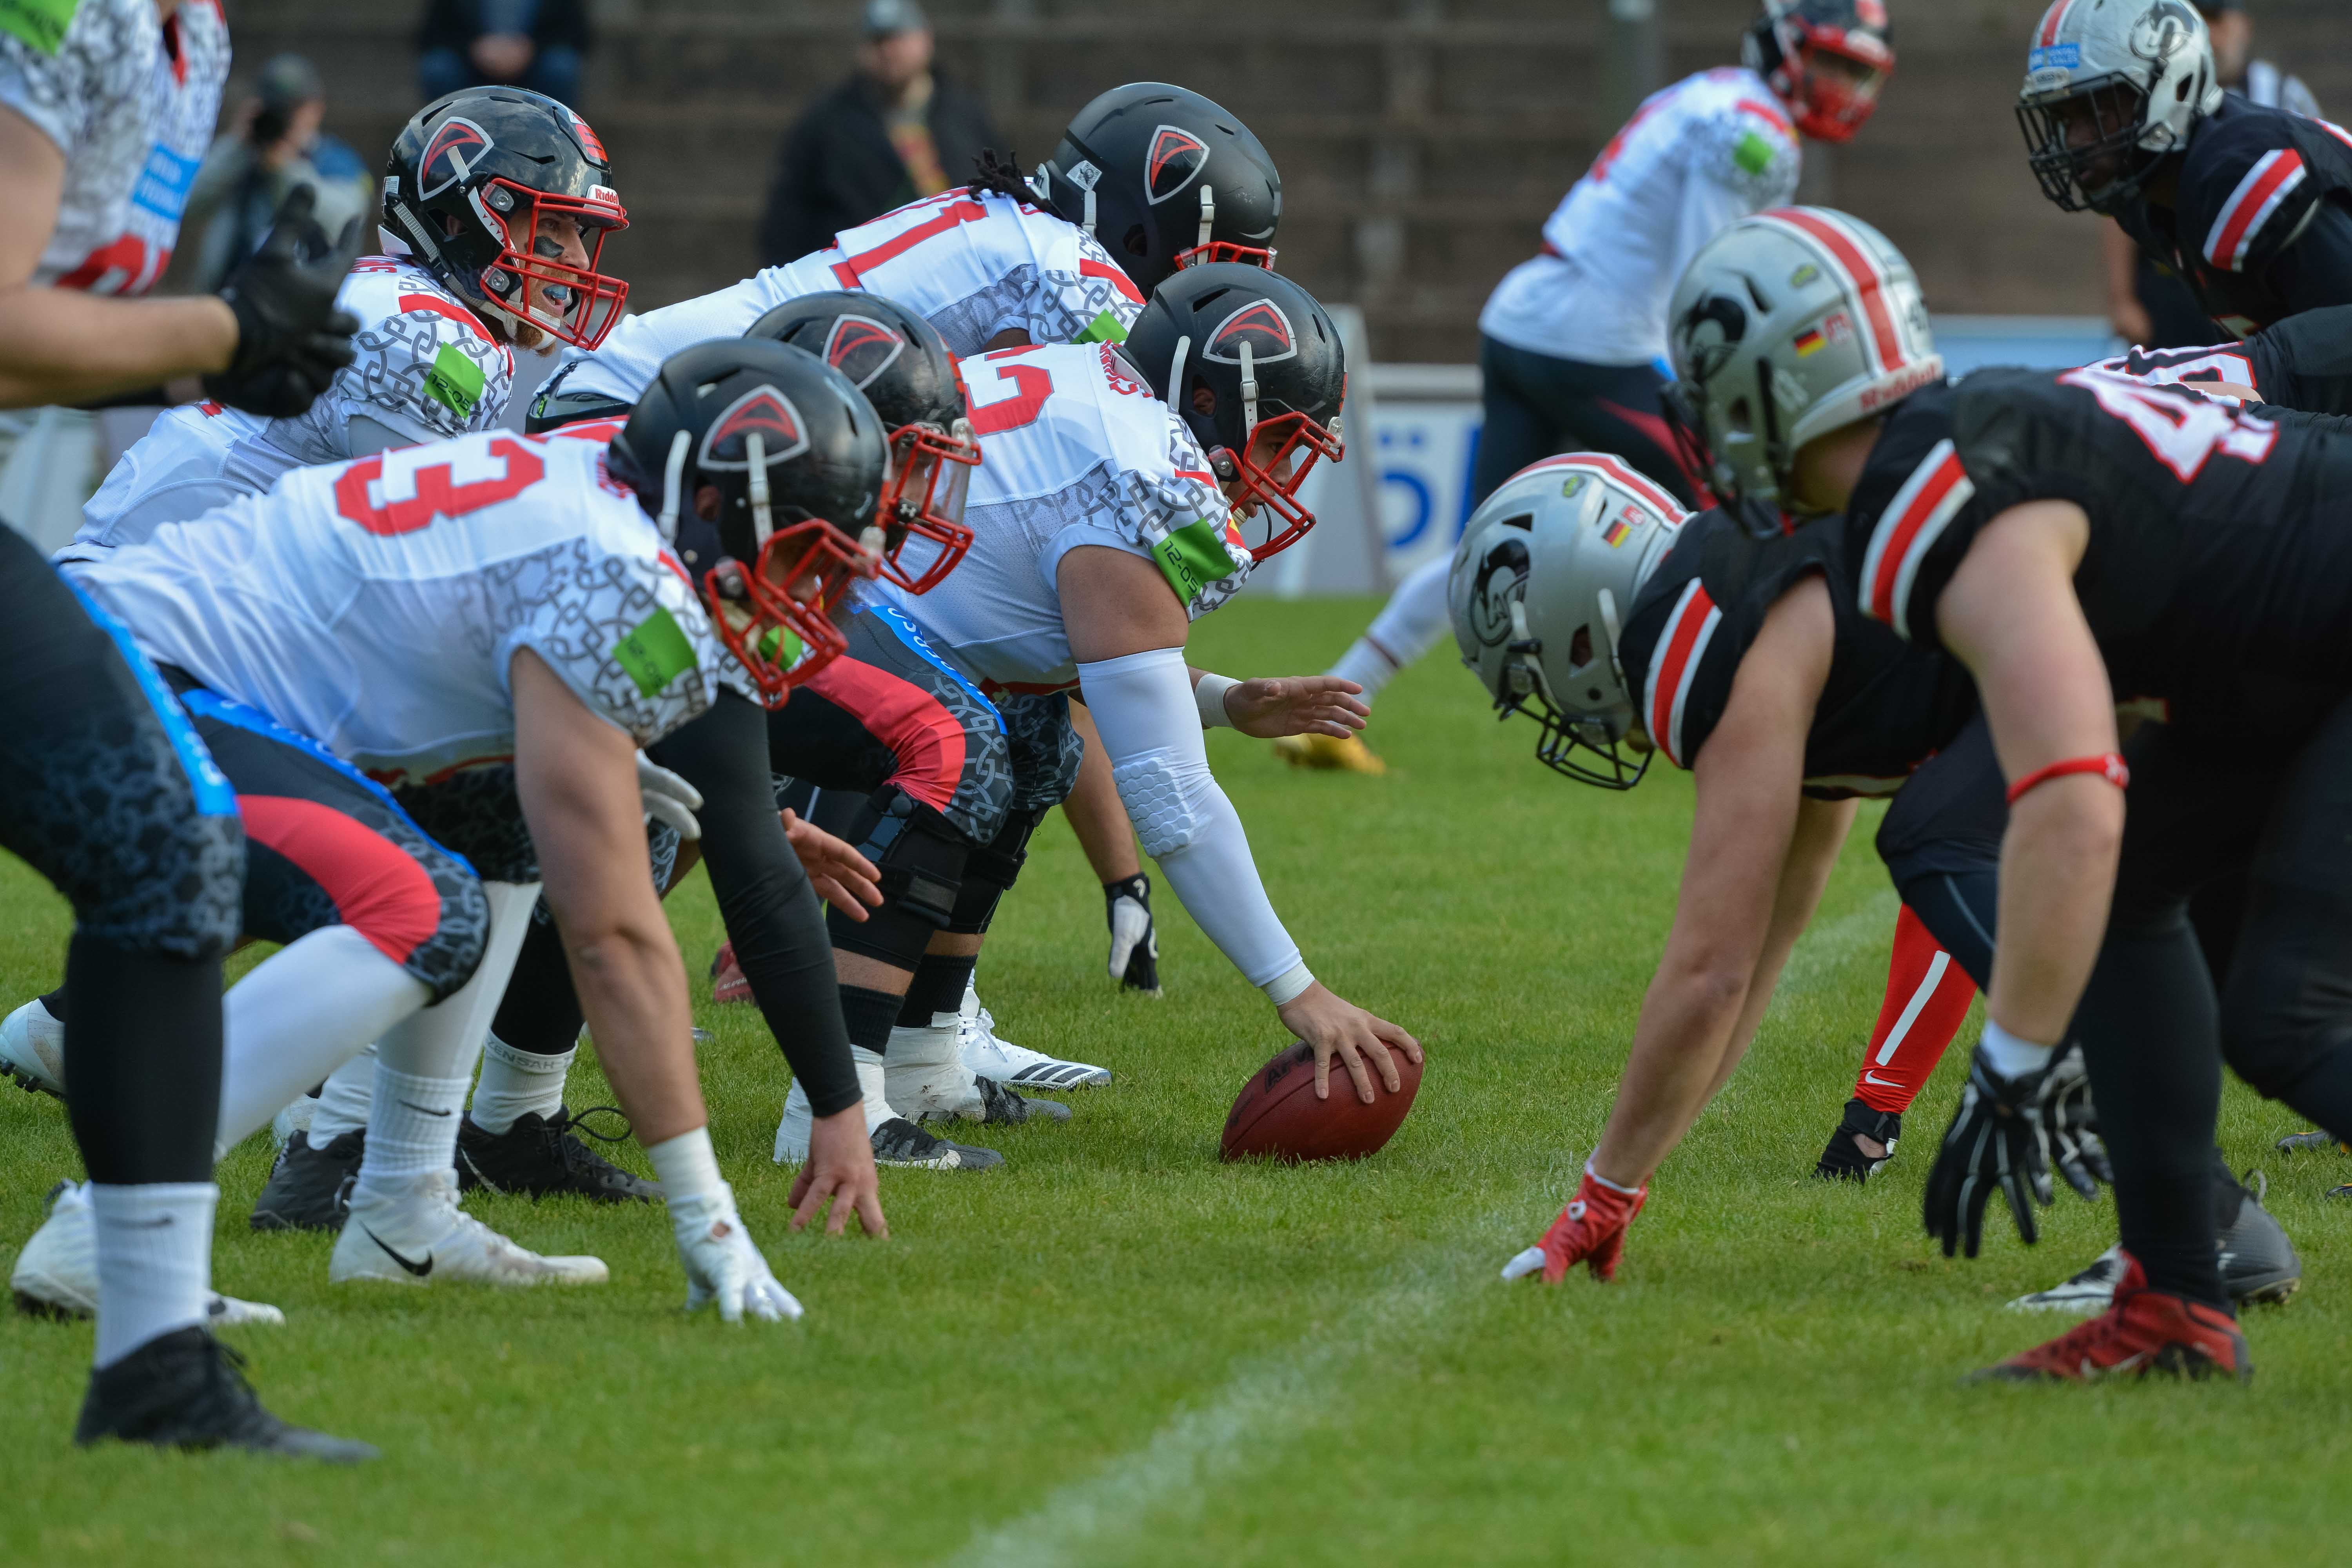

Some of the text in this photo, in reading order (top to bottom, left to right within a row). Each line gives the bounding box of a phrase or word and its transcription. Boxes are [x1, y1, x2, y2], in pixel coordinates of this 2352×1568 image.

[432, 373, 470, 412] 12-05
[1164, 540, 1199, 593] 12-05
[488, 1041, 555, 1069] ZENSAH
